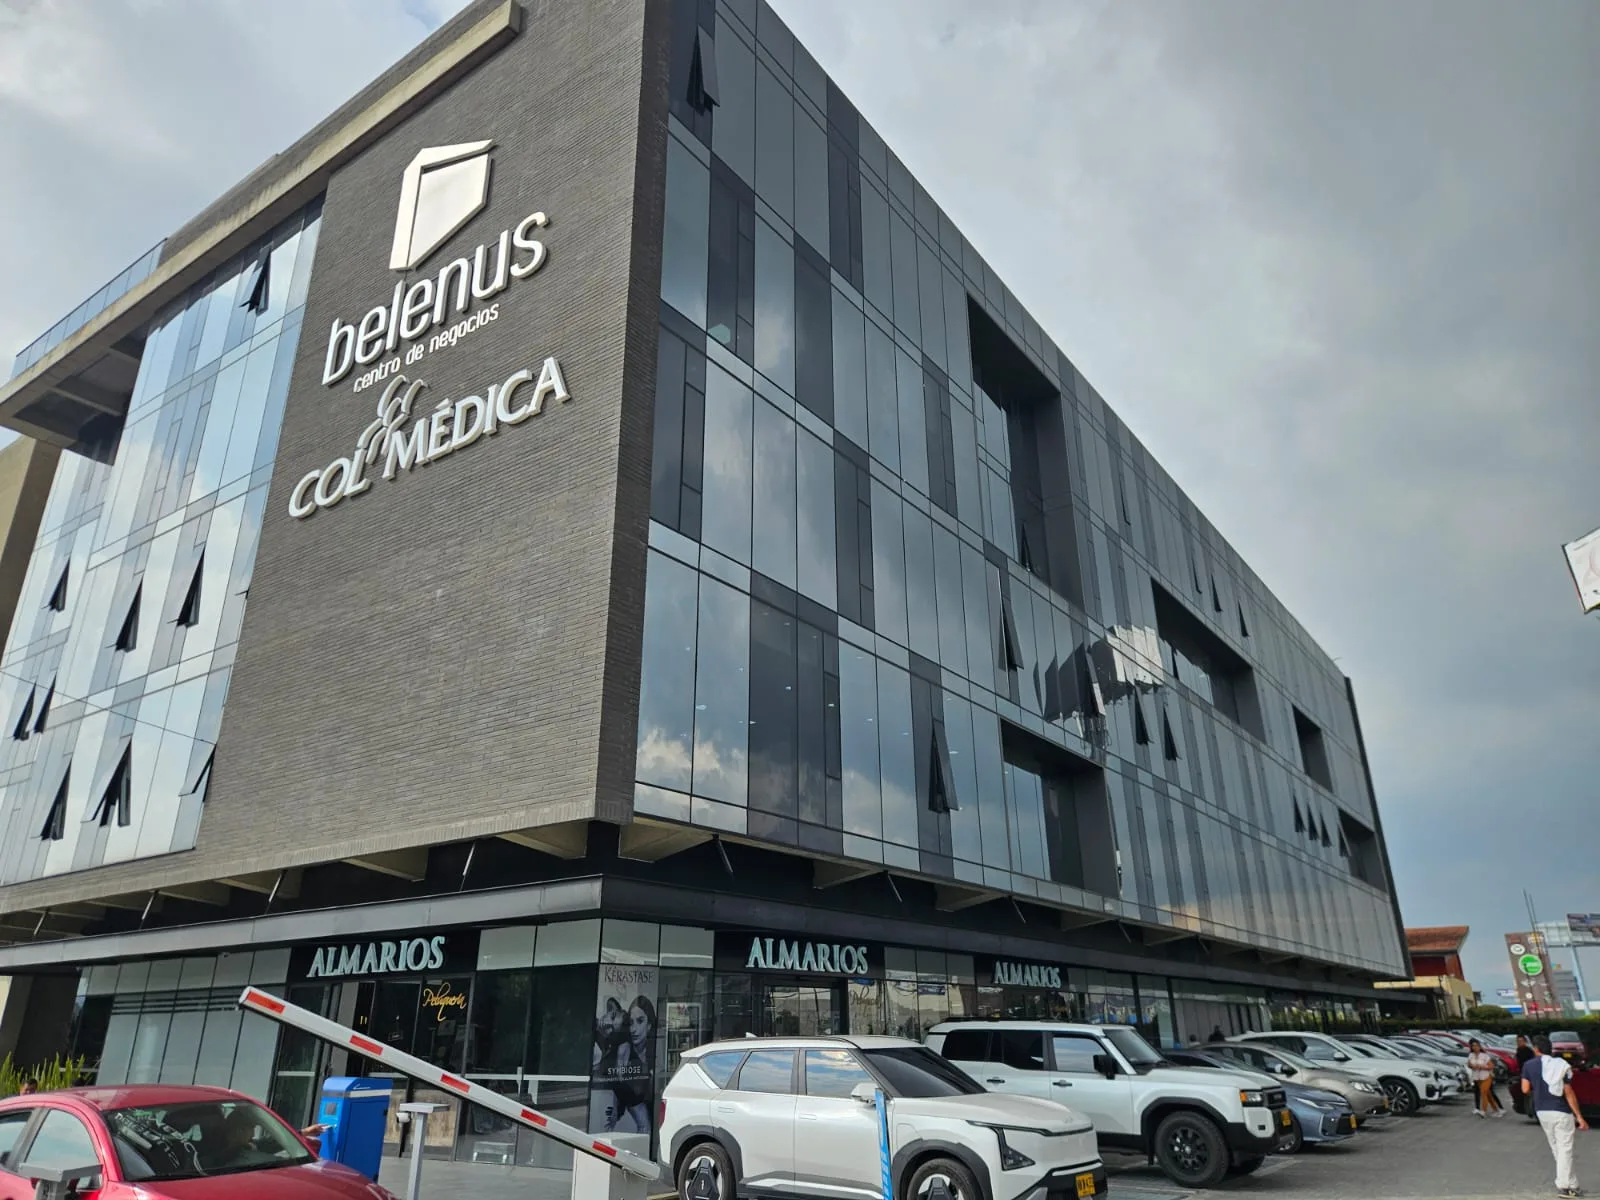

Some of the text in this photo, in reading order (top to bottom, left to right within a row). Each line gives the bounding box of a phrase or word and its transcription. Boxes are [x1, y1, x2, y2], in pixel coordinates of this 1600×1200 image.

[322, 211, 549, 387] belenus
[353, 303, 500, 393] centro de negocios
[306, 935, 446, 978] ALMARIOS
[745, 936, 869, 975] ALMARIOS
[994, 960, 1062, 988] ALMARIOS
